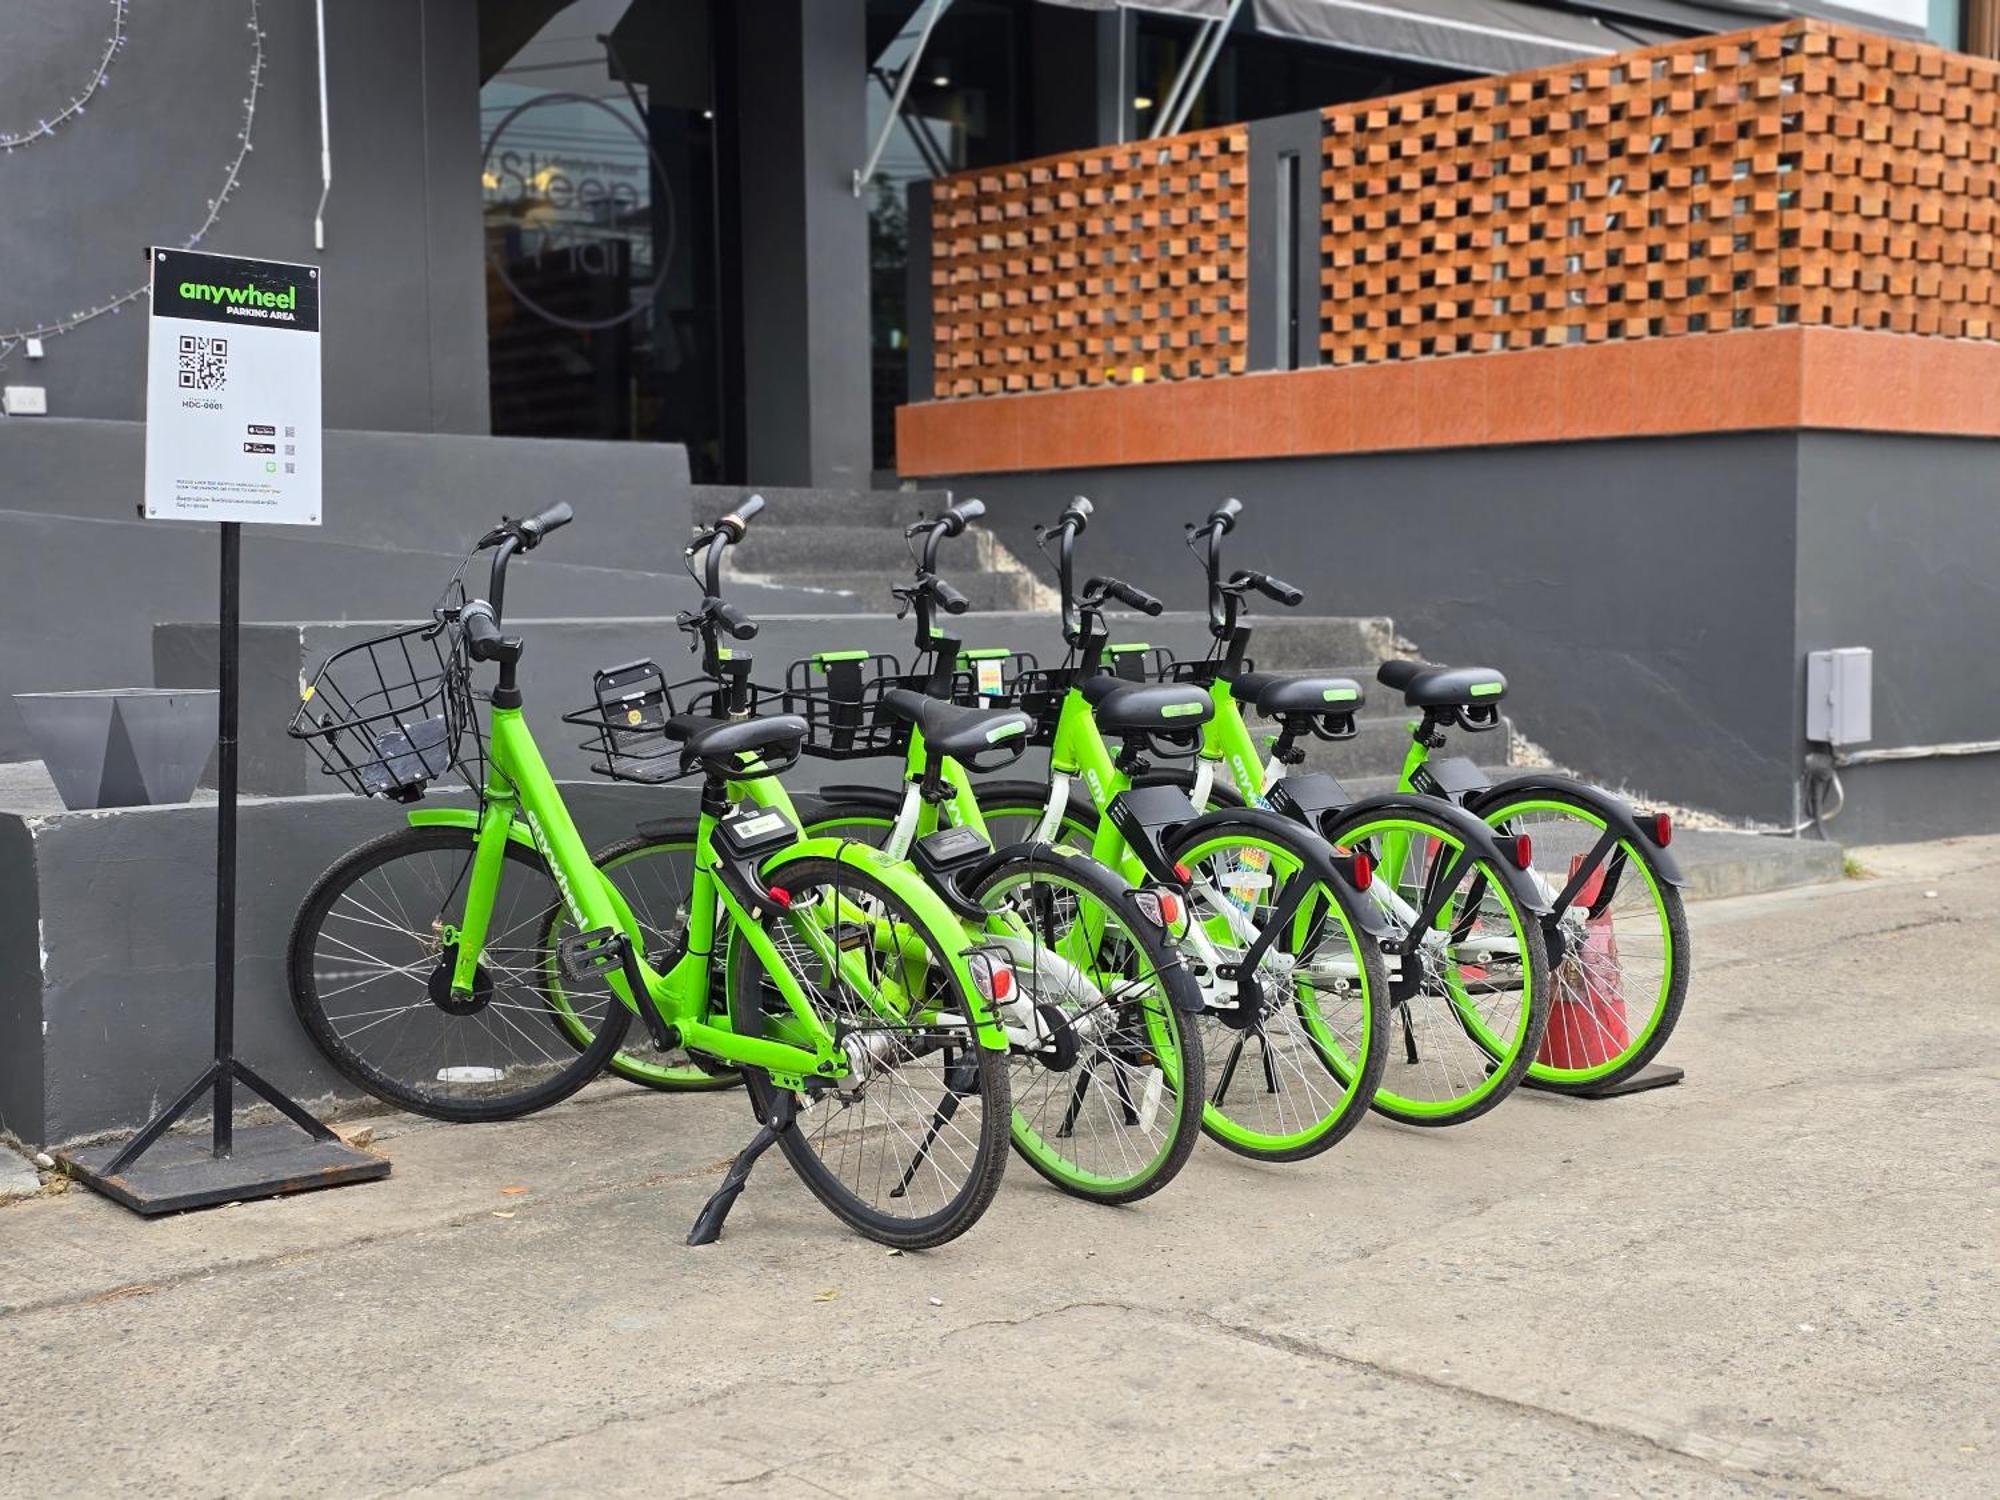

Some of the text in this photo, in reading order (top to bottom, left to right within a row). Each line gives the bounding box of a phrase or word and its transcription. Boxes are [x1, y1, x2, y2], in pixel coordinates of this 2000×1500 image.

[501, 151, 640, 228] Sleep
[179, 281, 296, 310] anywheel
[226, 305, 297, 321] PARKING AREA
[527, 809, 590, 930] anywheel
